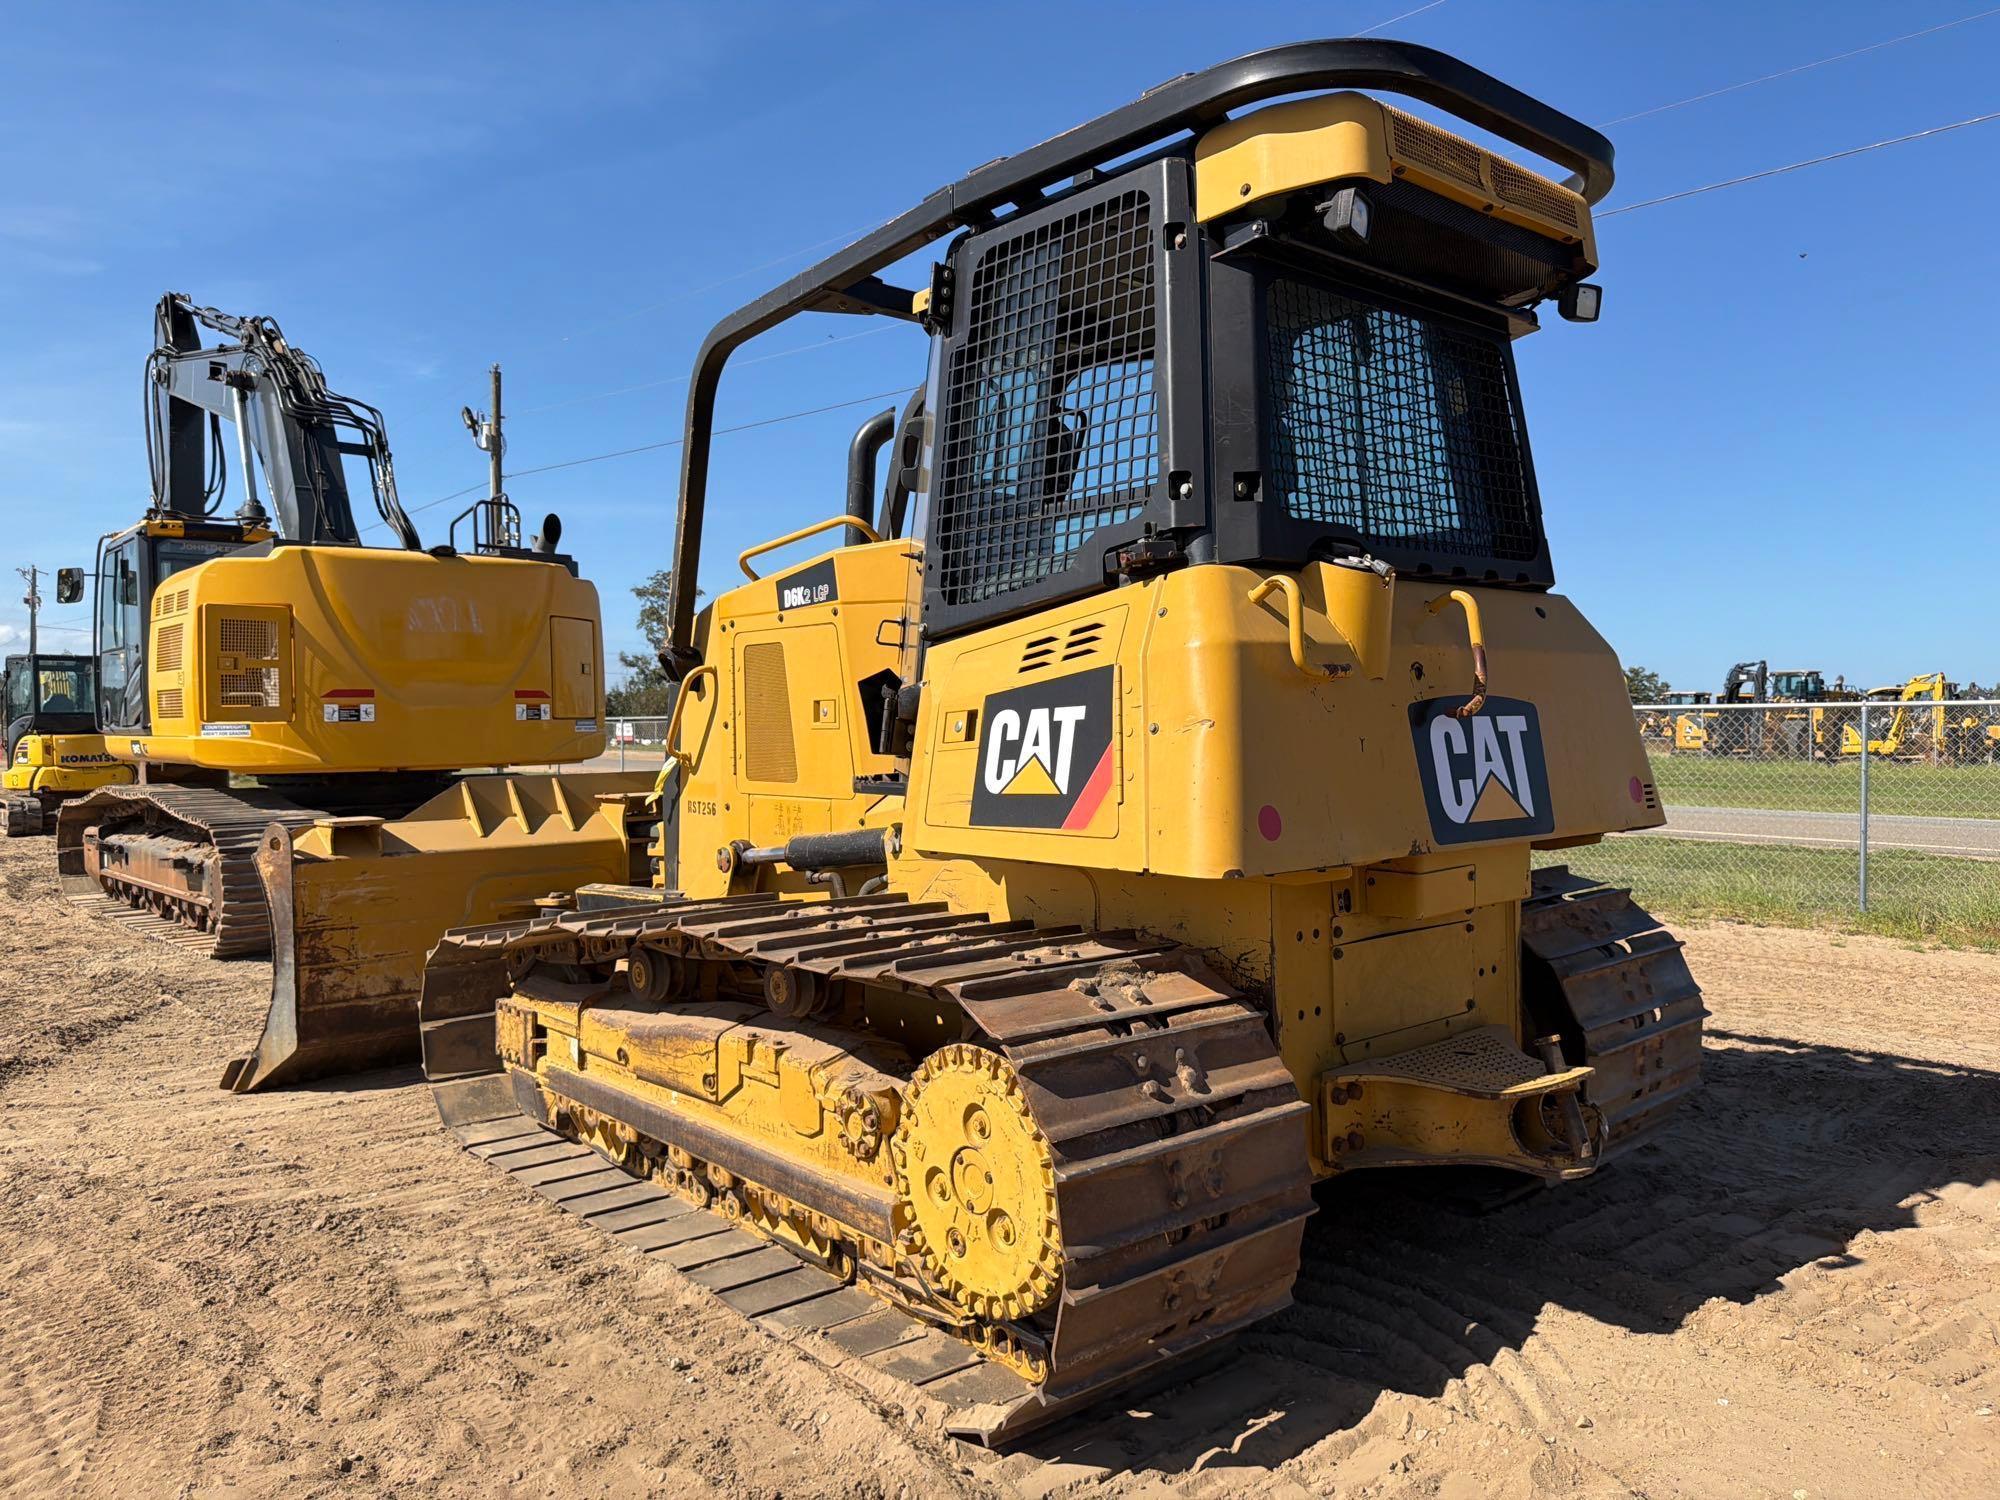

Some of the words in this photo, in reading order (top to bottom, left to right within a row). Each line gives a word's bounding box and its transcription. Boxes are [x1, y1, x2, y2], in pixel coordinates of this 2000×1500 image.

[813, 584, 829, 602] LGP
[985, 705, 1086, 795] CAT
[1430, 714, 1535, 824] CAT
